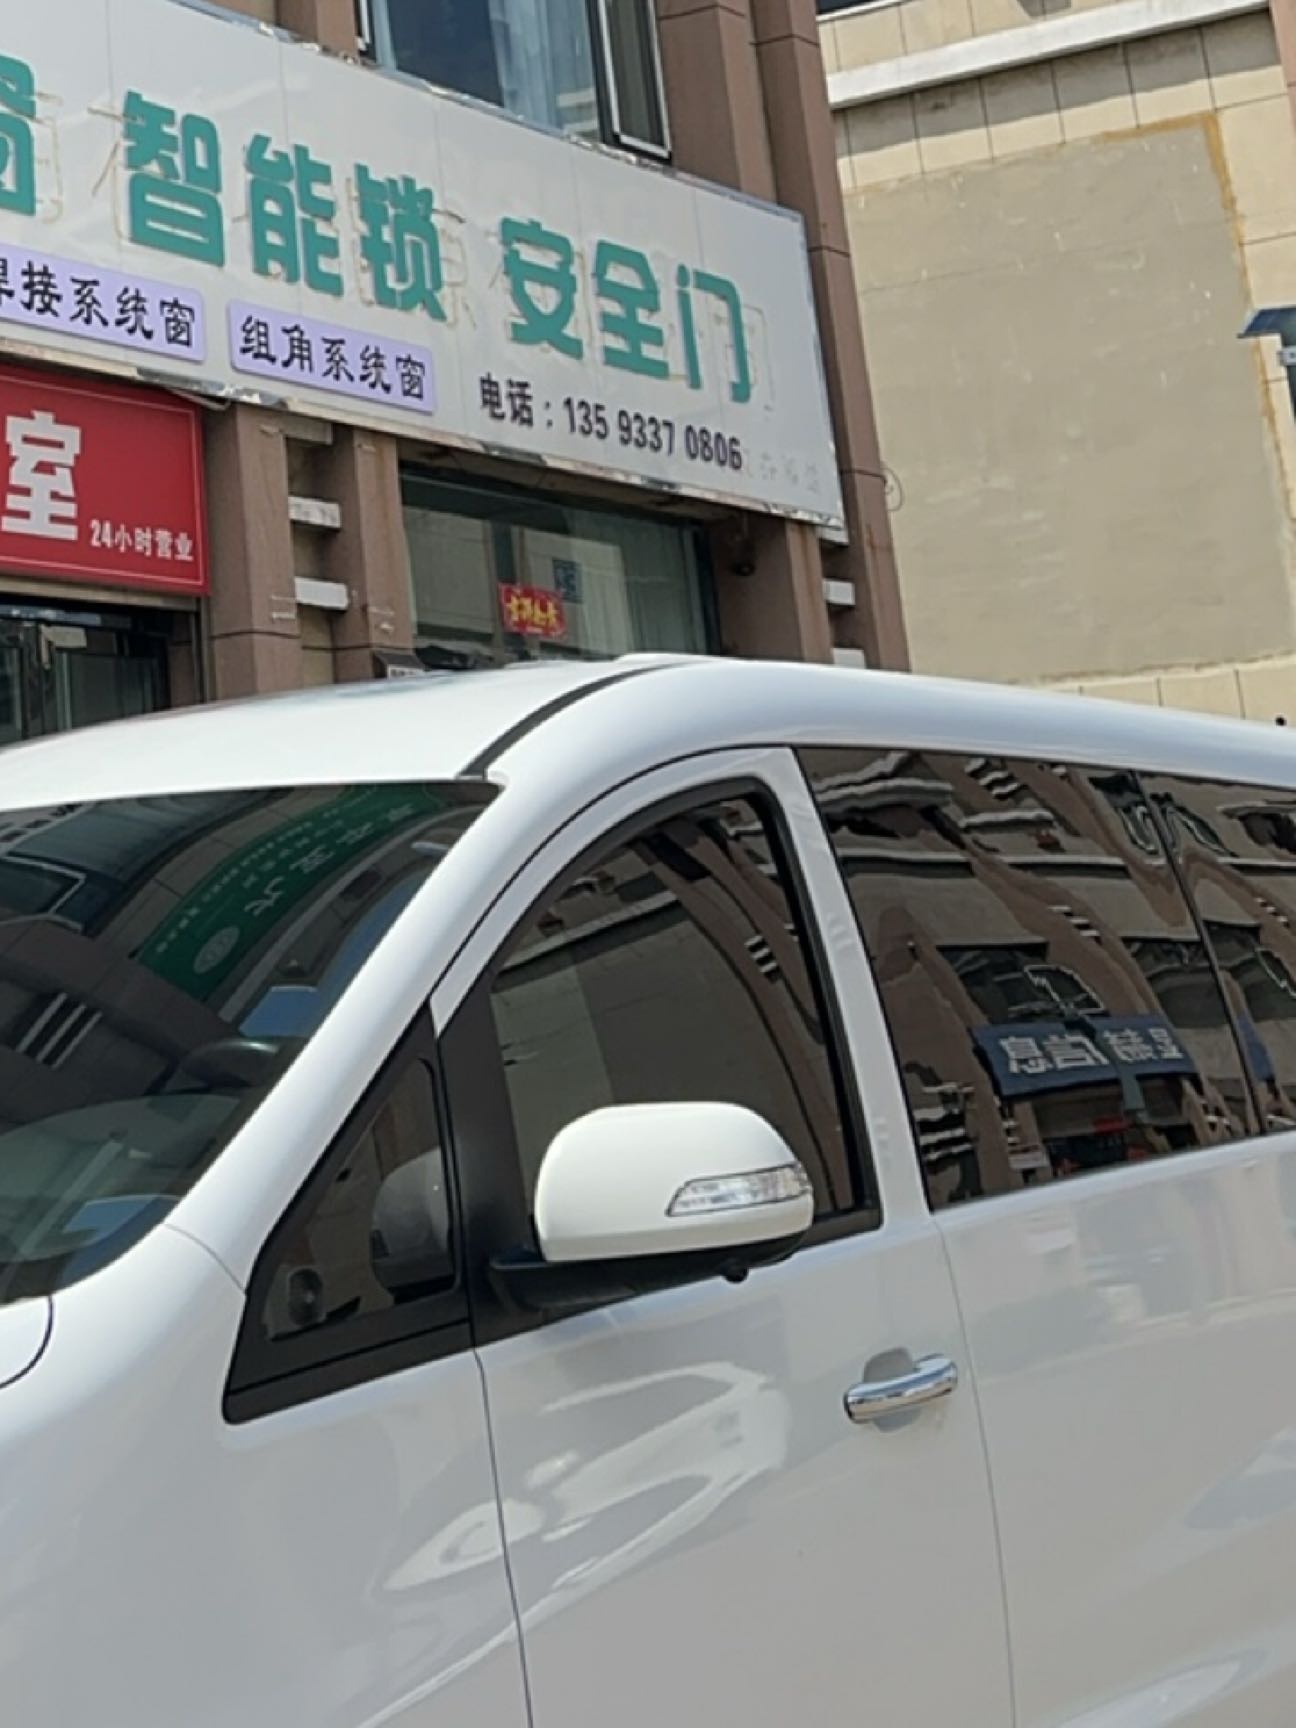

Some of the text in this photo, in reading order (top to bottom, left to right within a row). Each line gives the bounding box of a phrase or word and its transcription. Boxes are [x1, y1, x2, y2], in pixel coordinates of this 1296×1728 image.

[126, 93, 442, 315] 智能锁
[502, 219, 748, 397] 安全门
[239, 316, 425, 400] 组角系统窗
[91, 519, 193, 561] 24小时营业
